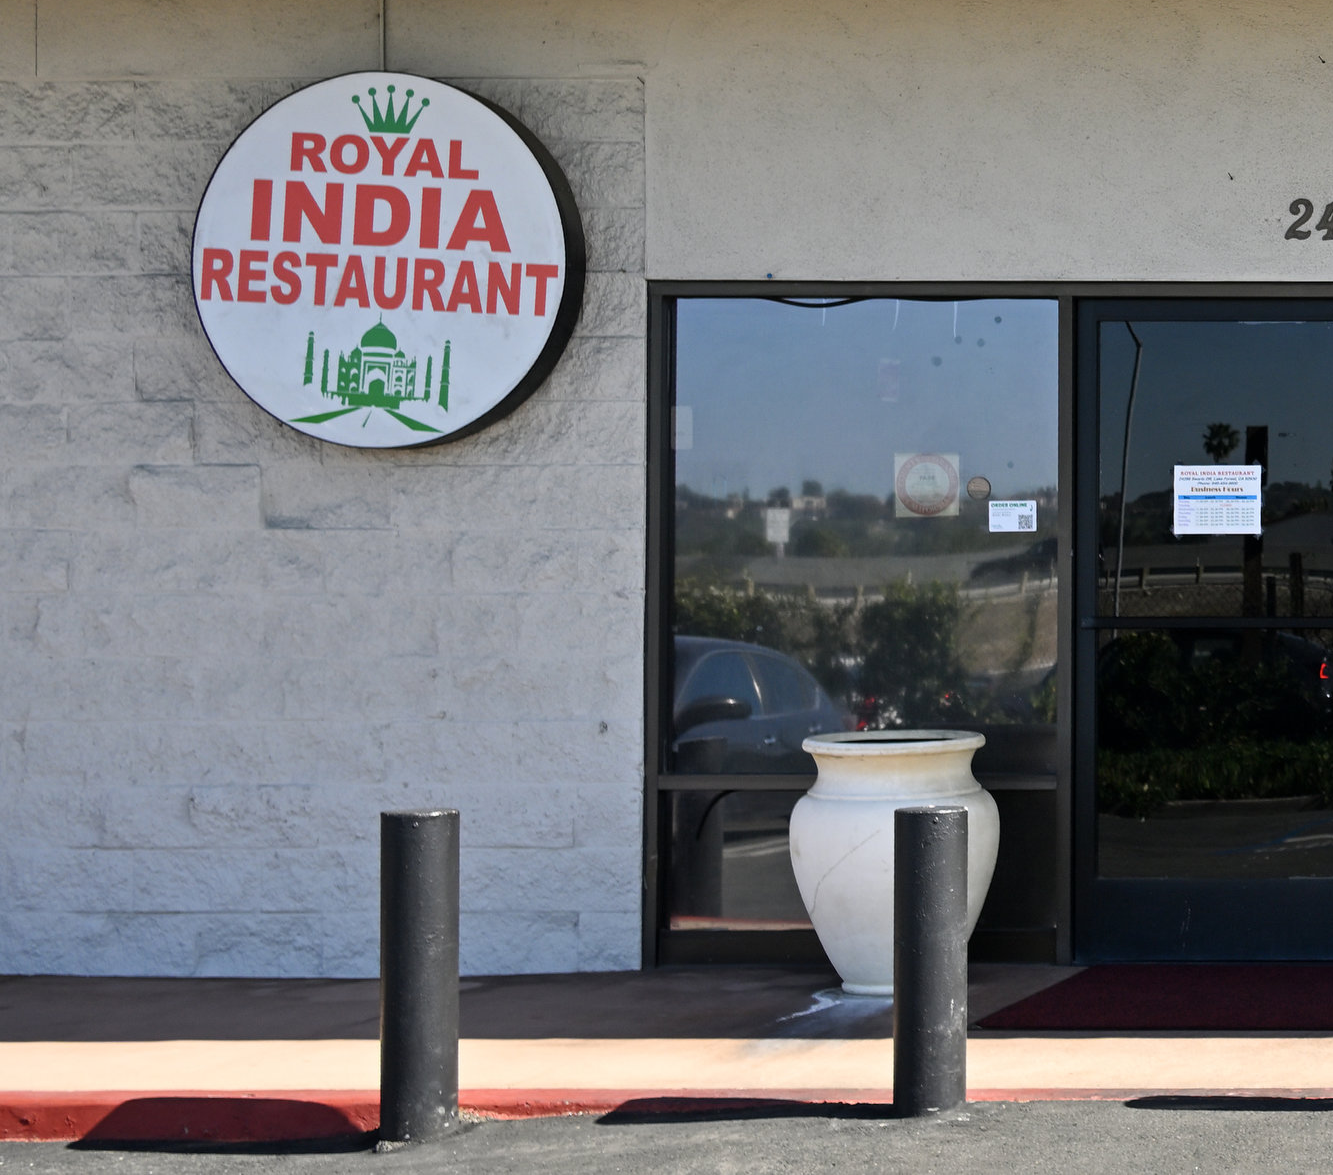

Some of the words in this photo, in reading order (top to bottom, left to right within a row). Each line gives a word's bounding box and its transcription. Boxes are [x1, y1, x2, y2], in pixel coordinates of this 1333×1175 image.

[290, 132, 479, 180] ROYAL
[250, 179, 511, 253] INDIA
[201, 248, 559, 317] RESTAURANT
